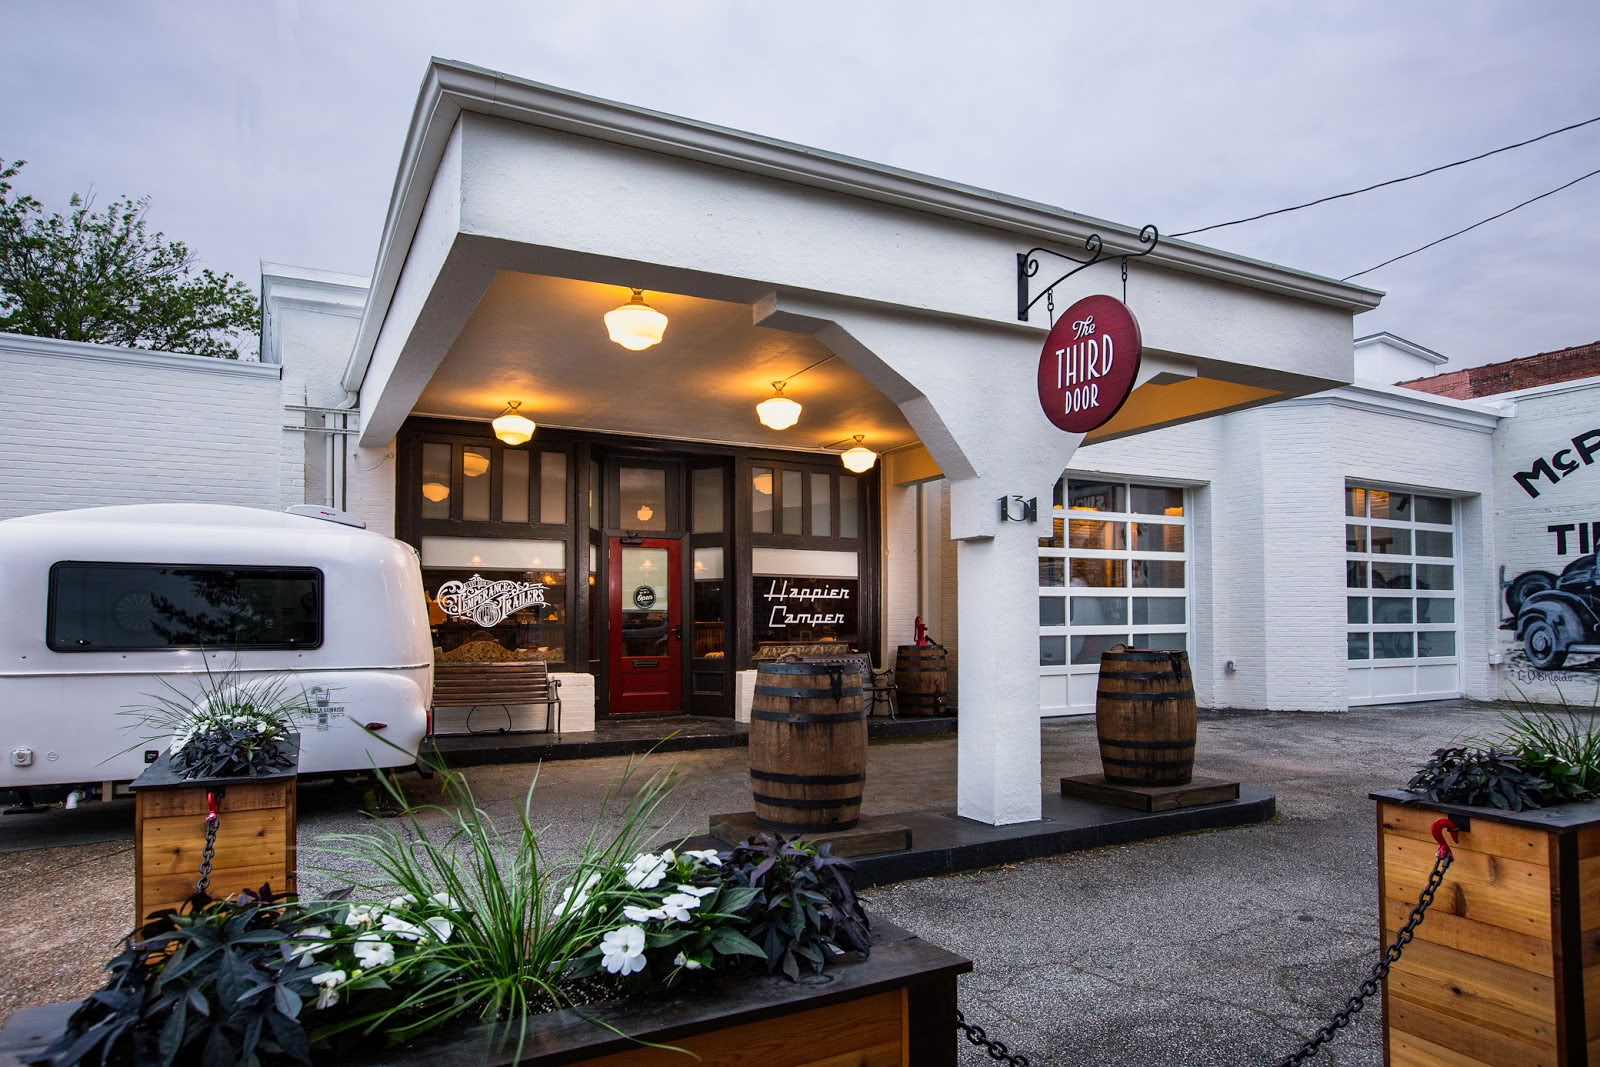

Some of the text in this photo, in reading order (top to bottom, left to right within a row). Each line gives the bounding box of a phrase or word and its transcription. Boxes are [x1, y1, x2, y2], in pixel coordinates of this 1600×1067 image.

[1072, 315, 1096, 340] The
[1056, 334, 1113, 389] THIRD
[1065, 384, 1099, 414] DOOR
[997, 495, 1037, 522] 131
[445, 583, 511, 618] TEMPERANCE
[495, 589, 545, 618] TRAILERS
[637, 594, 653, 602] Open
[764, 580, 849, 602] Happier
[769, 606, 845, 627] Camper
